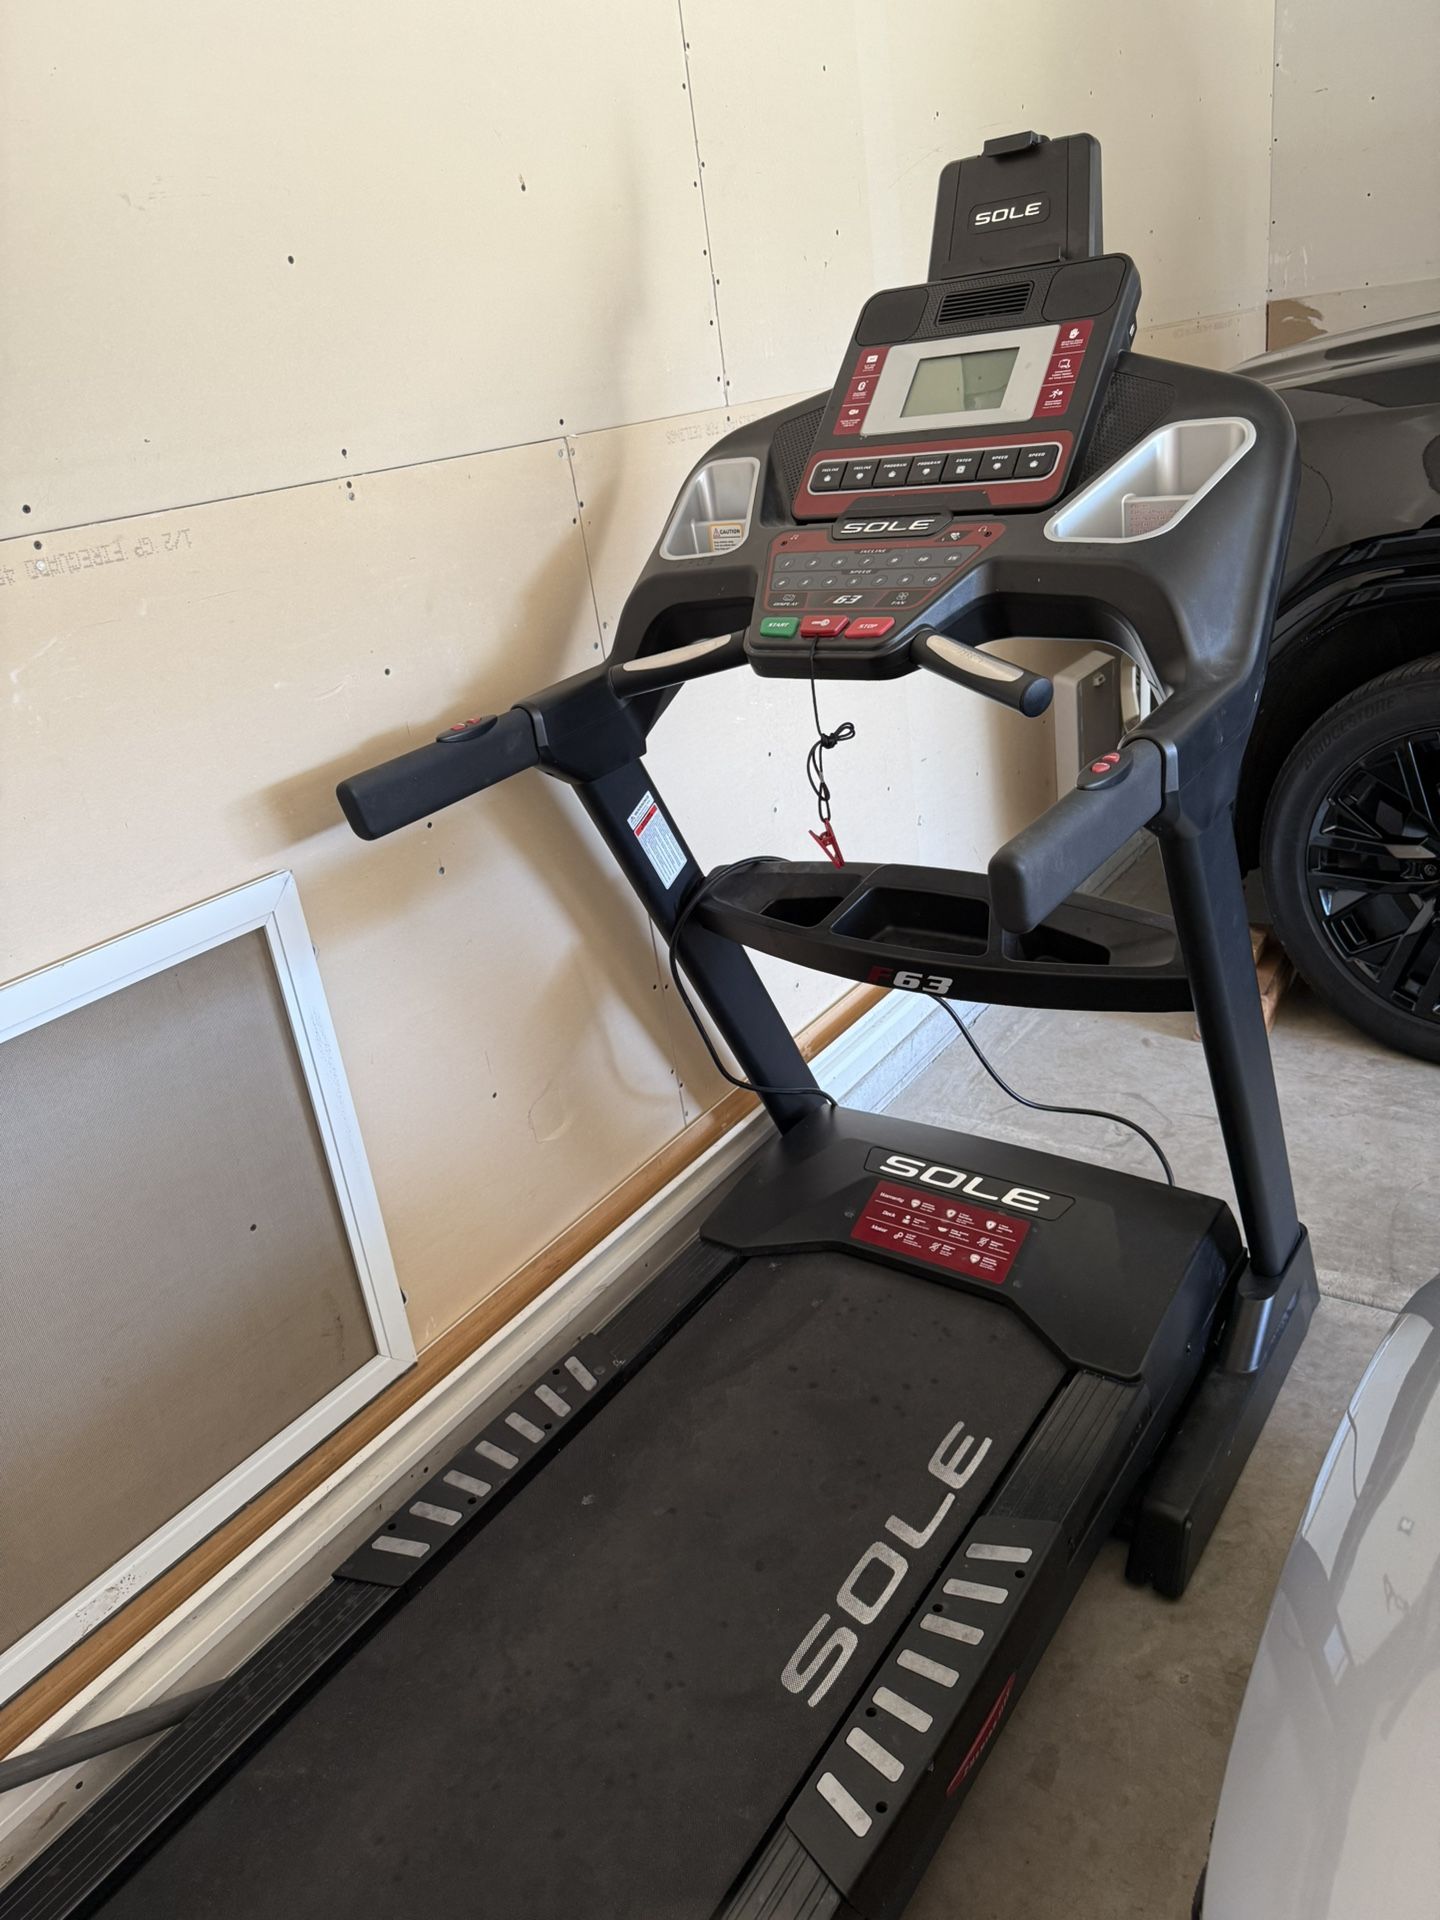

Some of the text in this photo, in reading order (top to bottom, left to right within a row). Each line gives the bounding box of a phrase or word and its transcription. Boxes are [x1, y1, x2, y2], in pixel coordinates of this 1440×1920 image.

[974, 201, 1042, 226] SOLE
[840, 519, 935, 534] SOLE
[880, 1155, 1051, 1212] SOLE
[780, 1421, 993, 1708] SOLE
